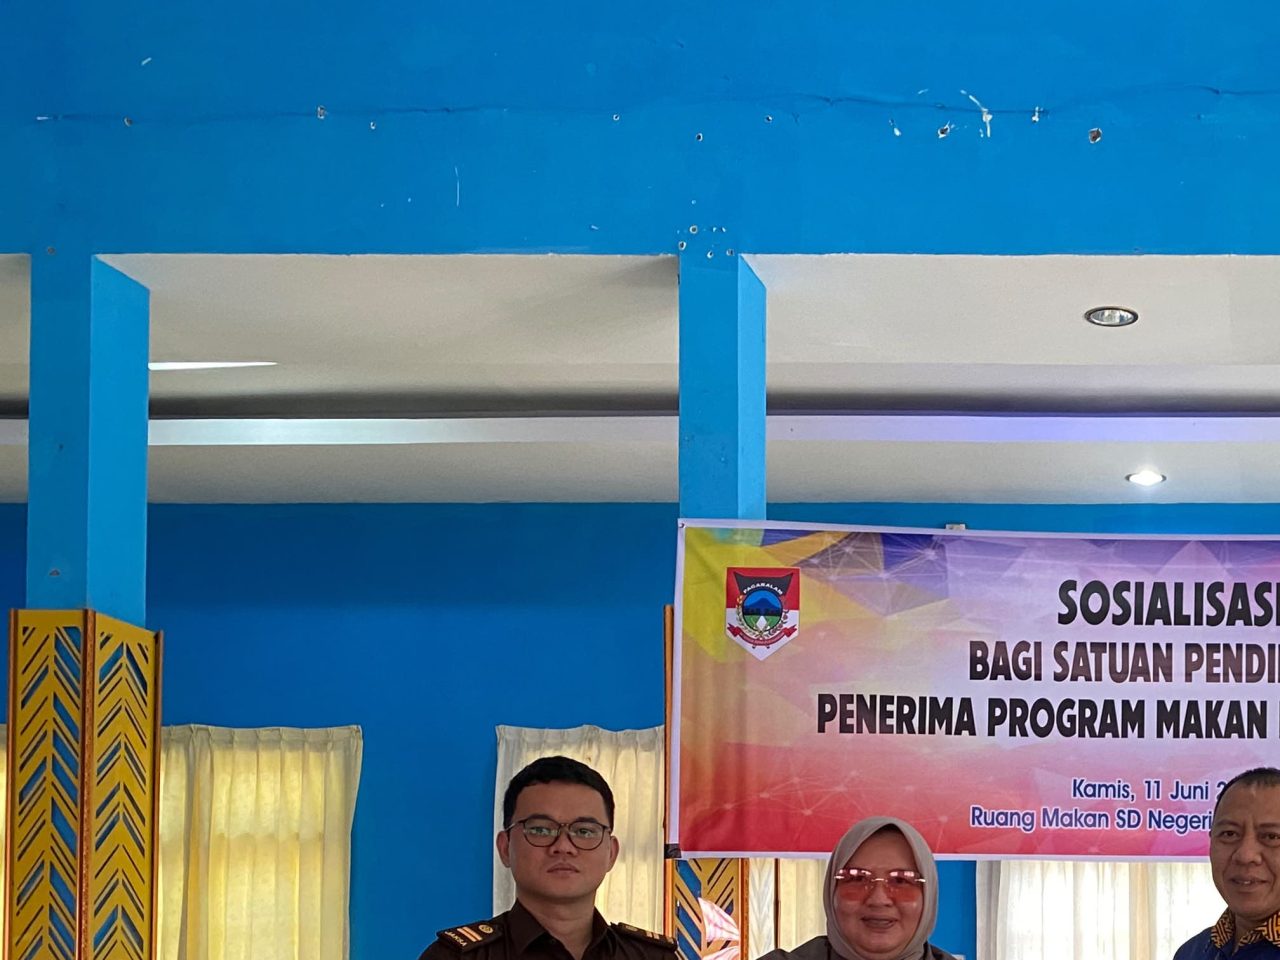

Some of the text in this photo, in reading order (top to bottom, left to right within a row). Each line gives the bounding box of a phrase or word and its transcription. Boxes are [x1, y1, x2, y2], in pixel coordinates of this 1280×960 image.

[969, 640, 1042, 682] BAGI
[1053, 641, 1173, 684] SATUAN
[817, 693, 977, 737] PENERIMA
[987, 697, 1145, 739] PROGRAM
[1156, 699, 1268, 739] MAKAN
[1072, 778, 1135, 802] Kamis,
[1144, 780, 1161, 799] 11
[1170, 780, 1209, 800] Juni
[971, 806, 1035, 832] Ruang
[1042, 808, 1109, 829] Makan
[1116, 809, 1141, 829] SD
[1148, 810, 1213, 833] Negeri
